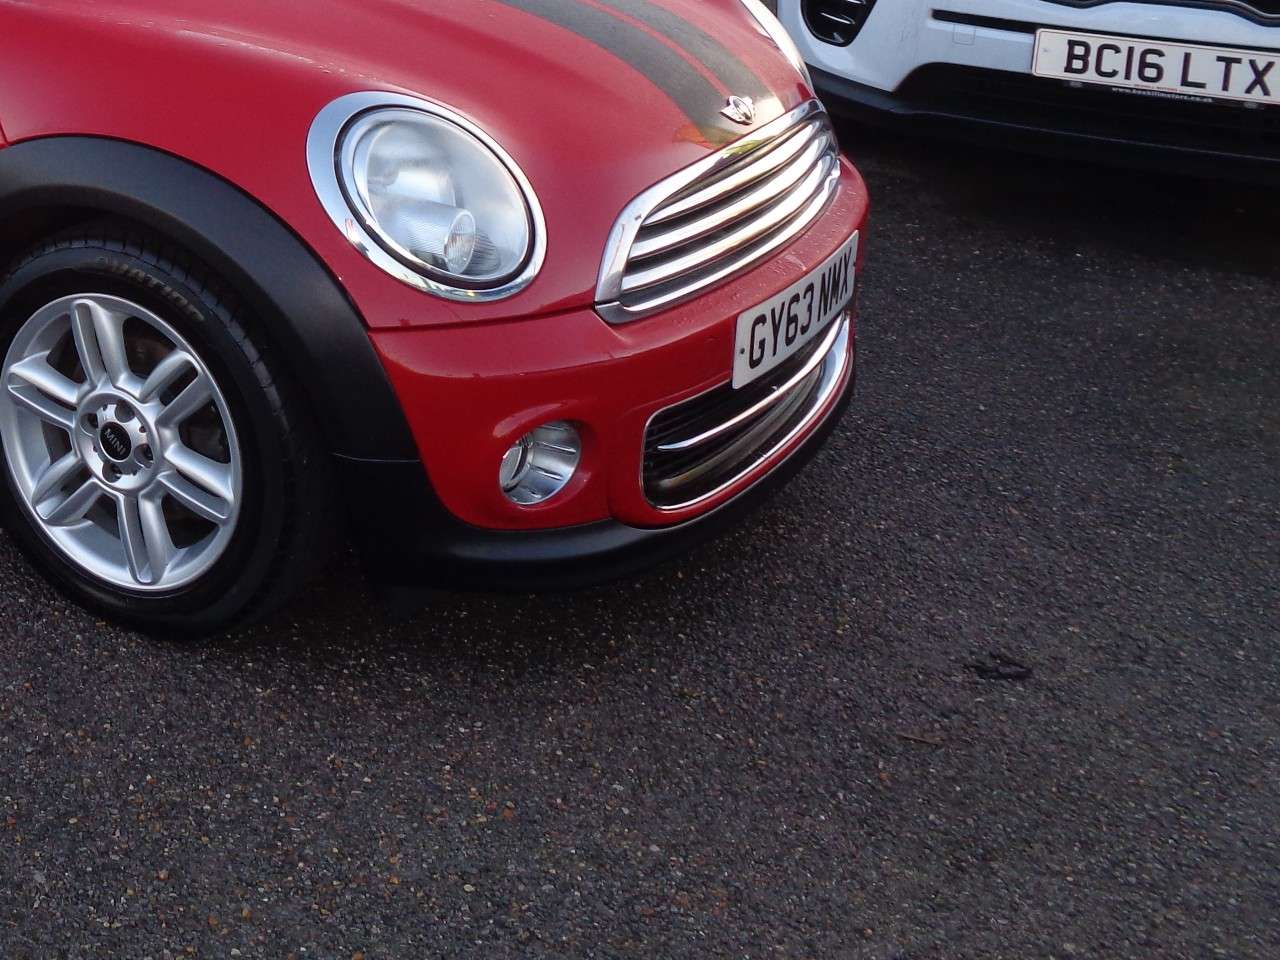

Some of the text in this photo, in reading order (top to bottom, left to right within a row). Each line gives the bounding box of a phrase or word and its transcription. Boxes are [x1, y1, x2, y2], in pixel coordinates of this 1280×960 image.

[1063, 39, 1276, 96] BC16 LTX
[749, 246, 853, 369] GY63 NMX
[104, 428, 126, 455] MINI
